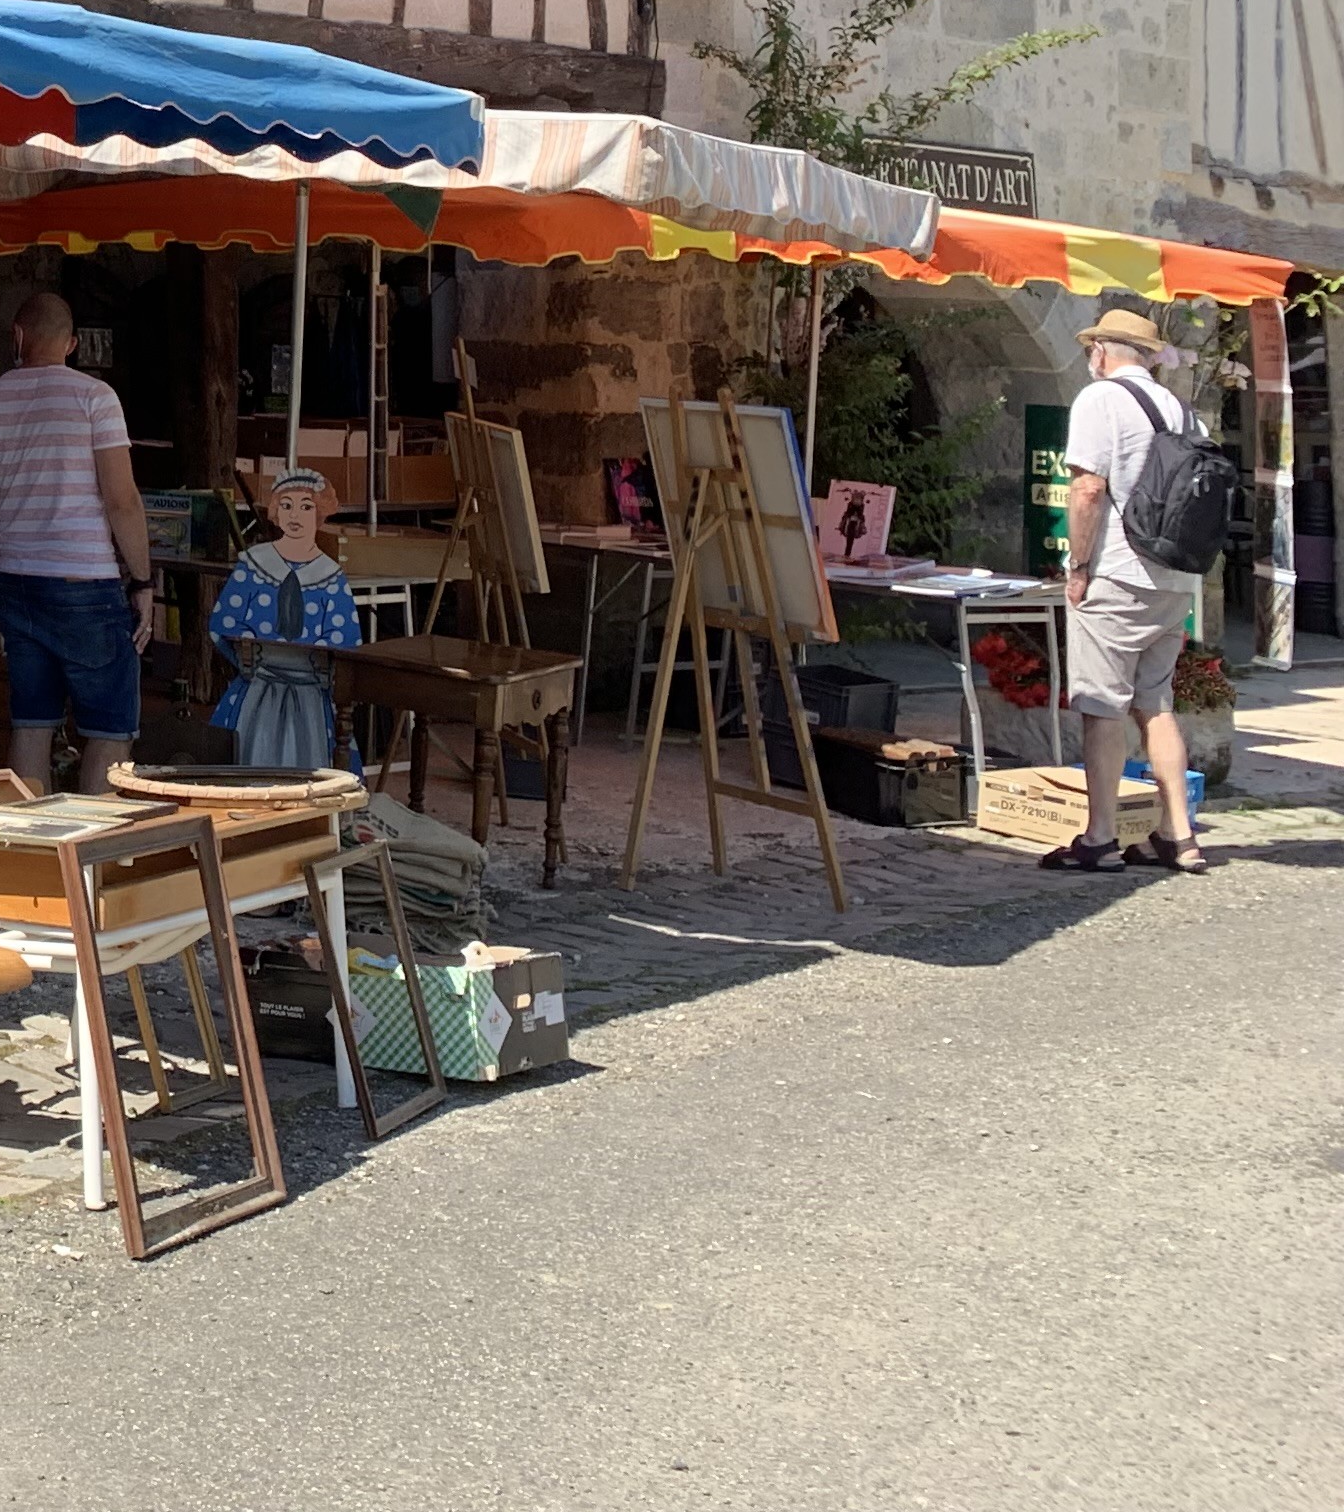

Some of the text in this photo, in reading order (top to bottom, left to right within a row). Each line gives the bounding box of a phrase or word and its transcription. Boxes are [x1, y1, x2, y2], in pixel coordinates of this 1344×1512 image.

[976, 165, 1029, 206] D'ART
[1031, 449, 1072, 478] EX
[153, 498, 190, 510] AVIONS
[1000, 799, 1063, 824] DX-7210(B)
